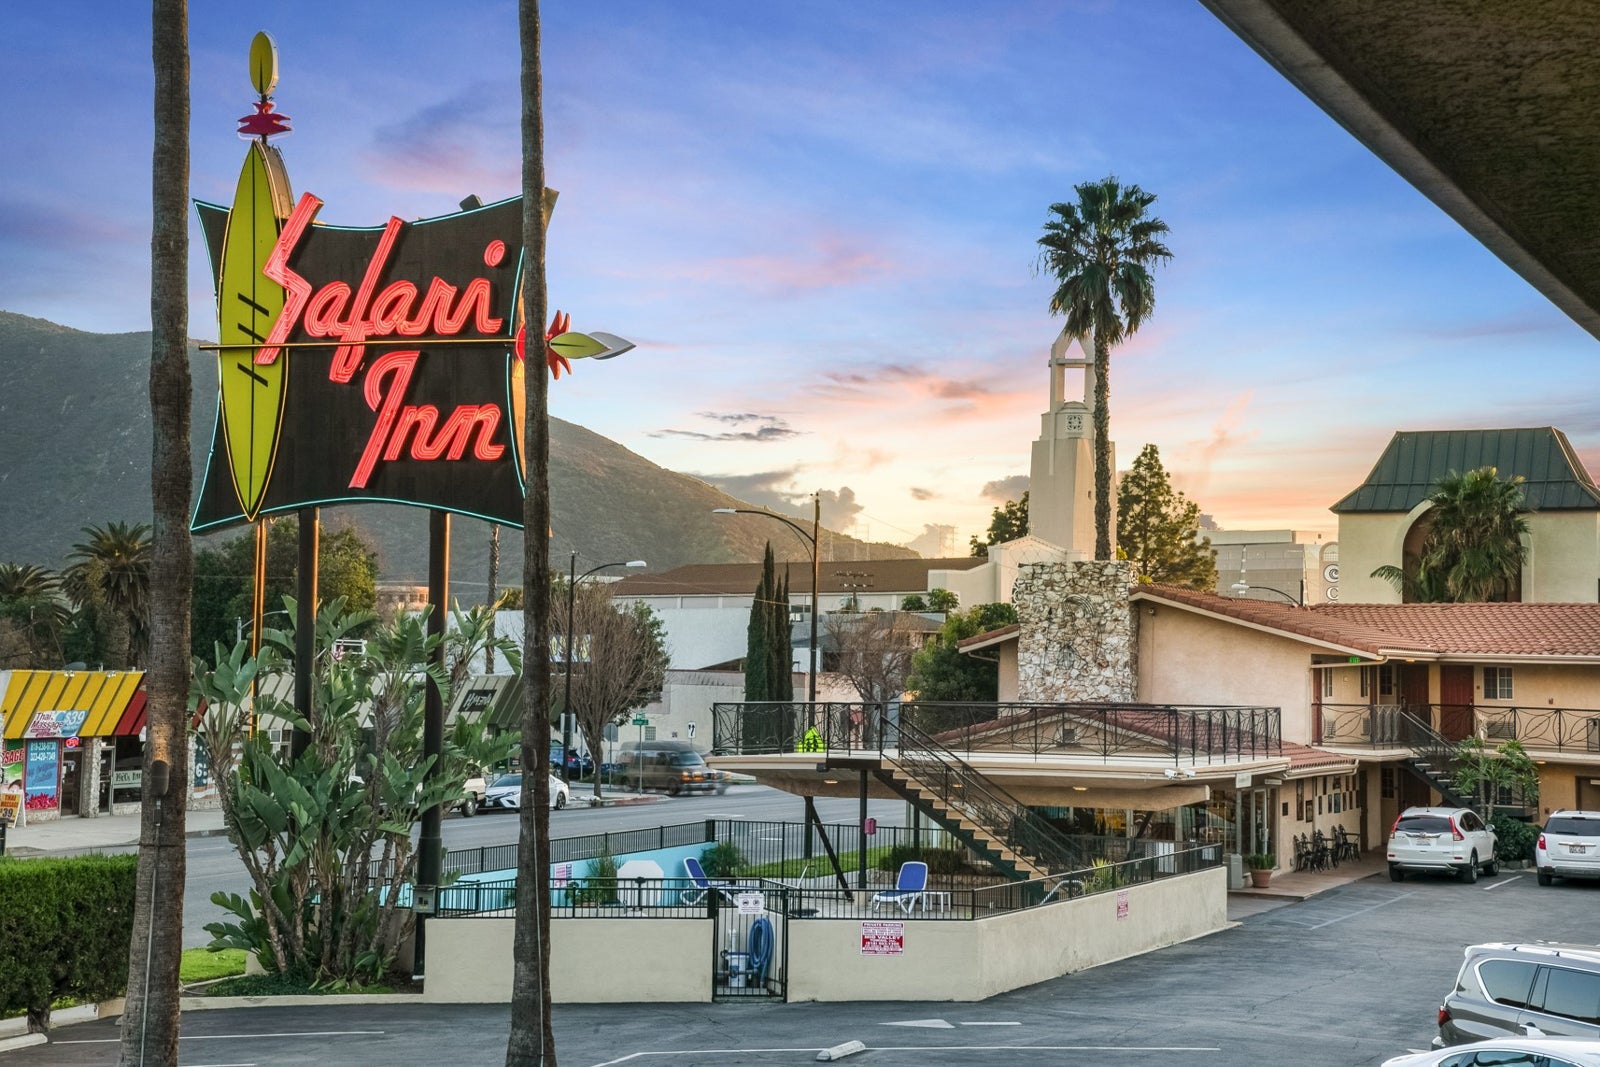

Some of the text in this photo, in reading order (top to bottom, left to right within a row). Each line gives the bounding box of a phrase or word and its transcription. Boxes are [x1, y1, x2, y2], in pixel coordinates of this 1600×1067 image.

[254, 191, 504, 384] Safari
[348, 350, 505, 489] Inn
[36, 712, 51, 721] Thai
[65, 711, 86, 725] $39
[31, 720, 64, 730] Massage
